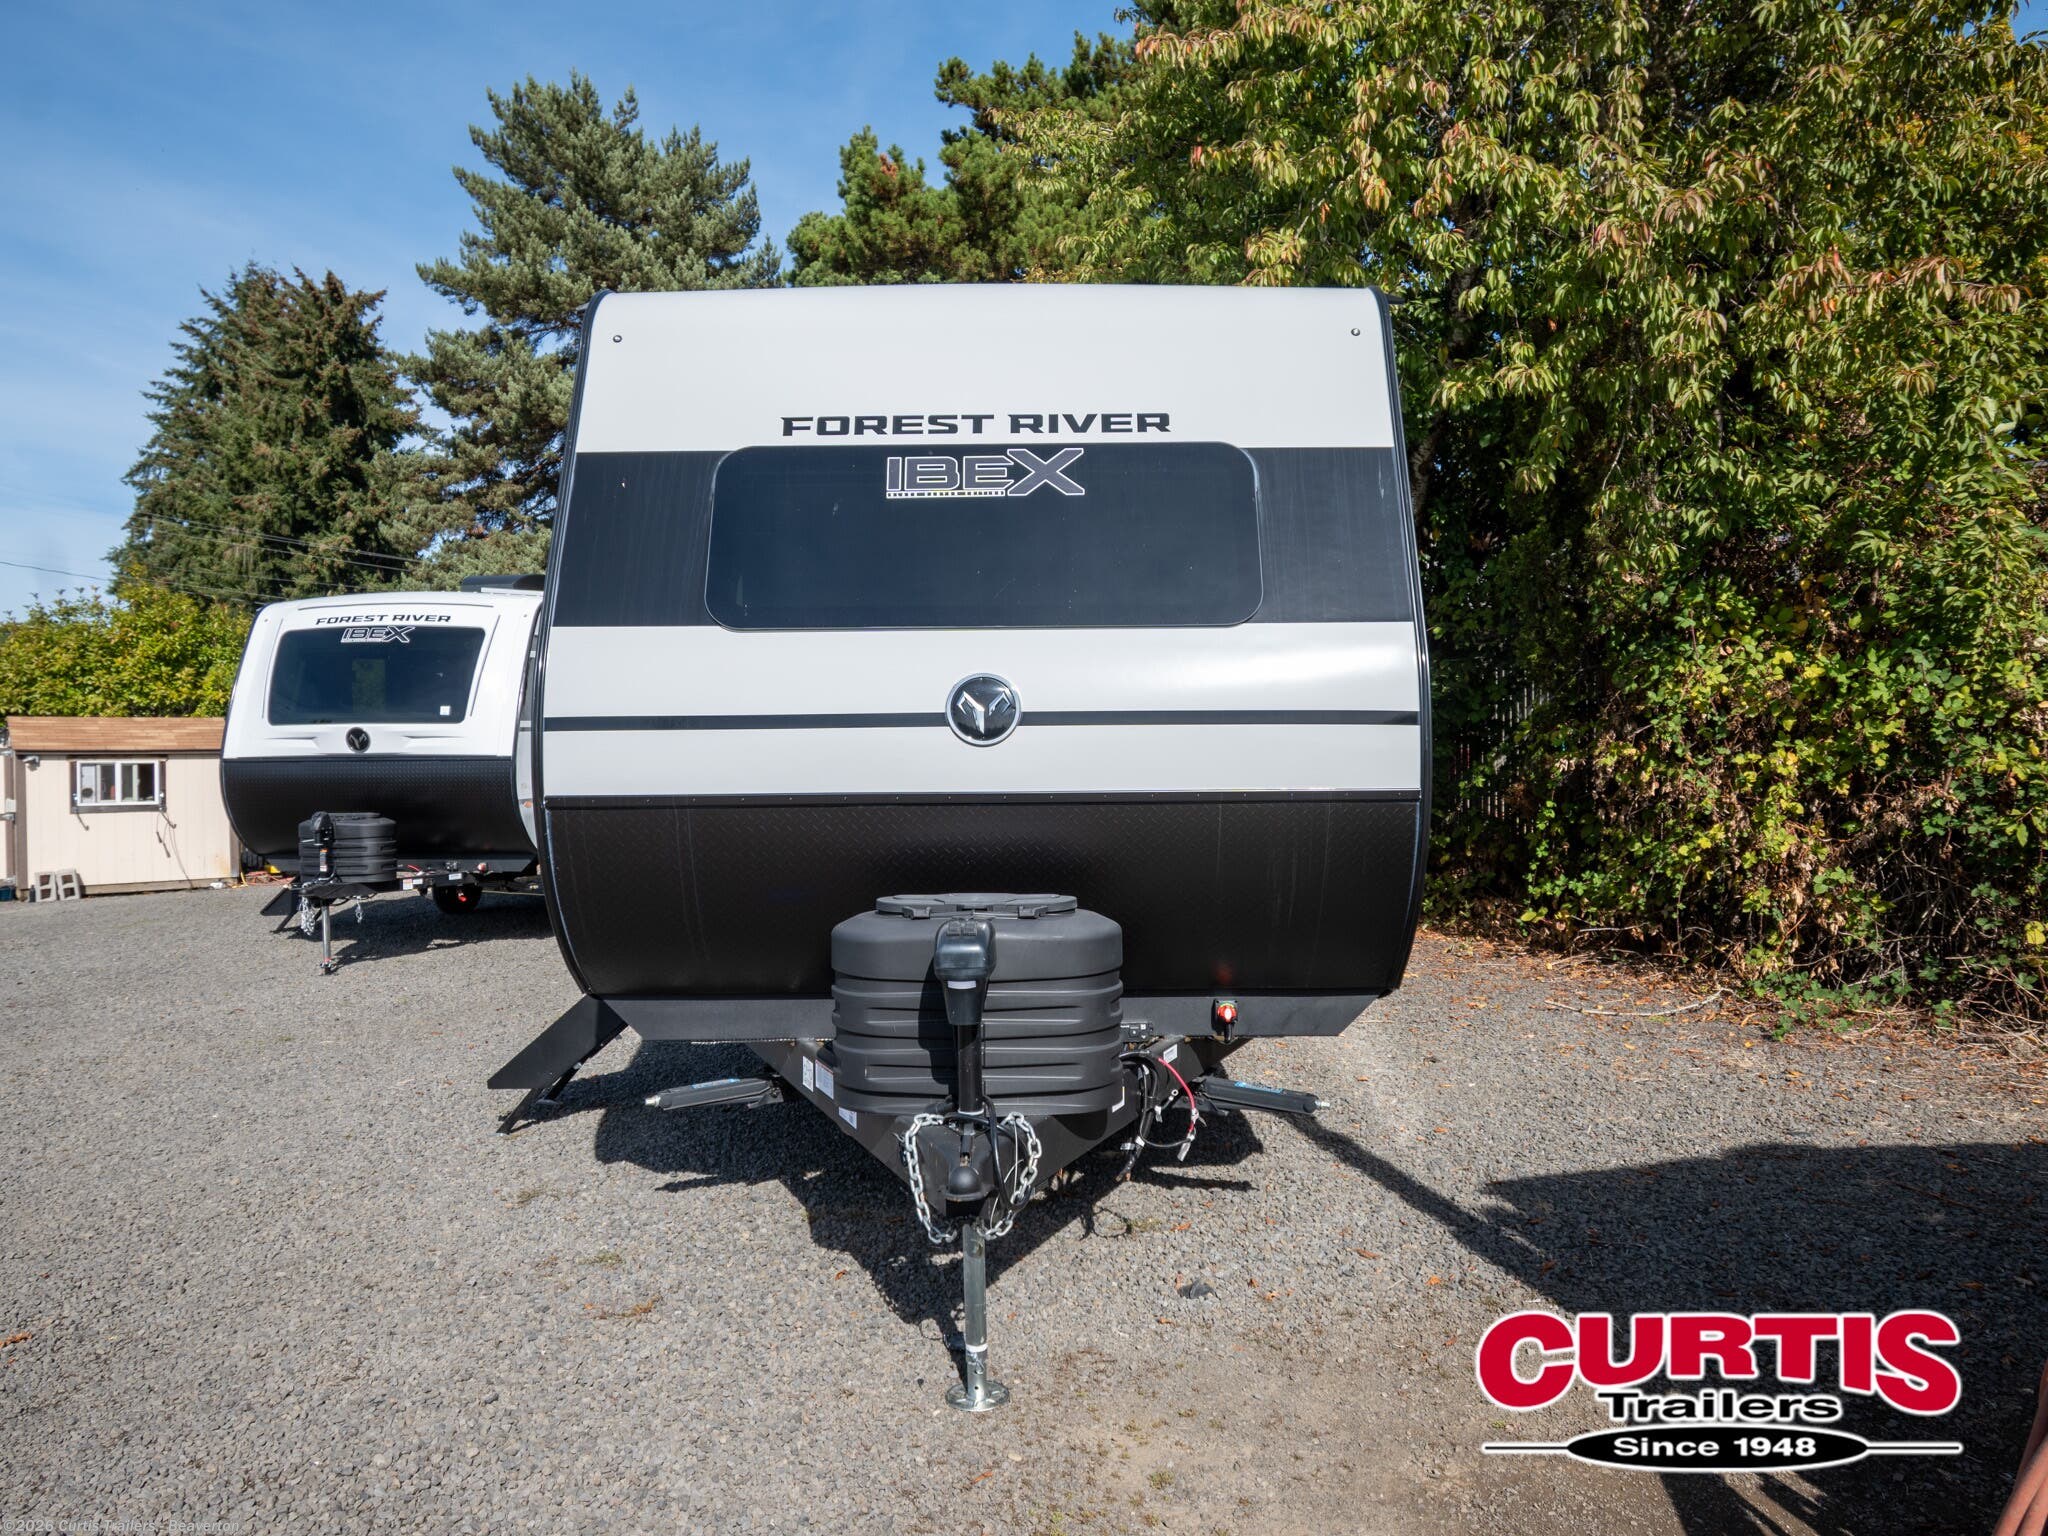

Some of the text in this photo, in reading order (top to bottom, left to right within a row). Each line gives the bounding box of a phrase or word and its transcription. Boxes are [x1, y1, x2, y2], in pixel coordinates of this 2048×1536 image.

[780, 412, 1171, 436] FOREST RIVER
[886, 448, 1085, 496] IBEX
[316, 614, 451, 625] FOREST RIVER
[340, 625, 416, 643] IBEX
